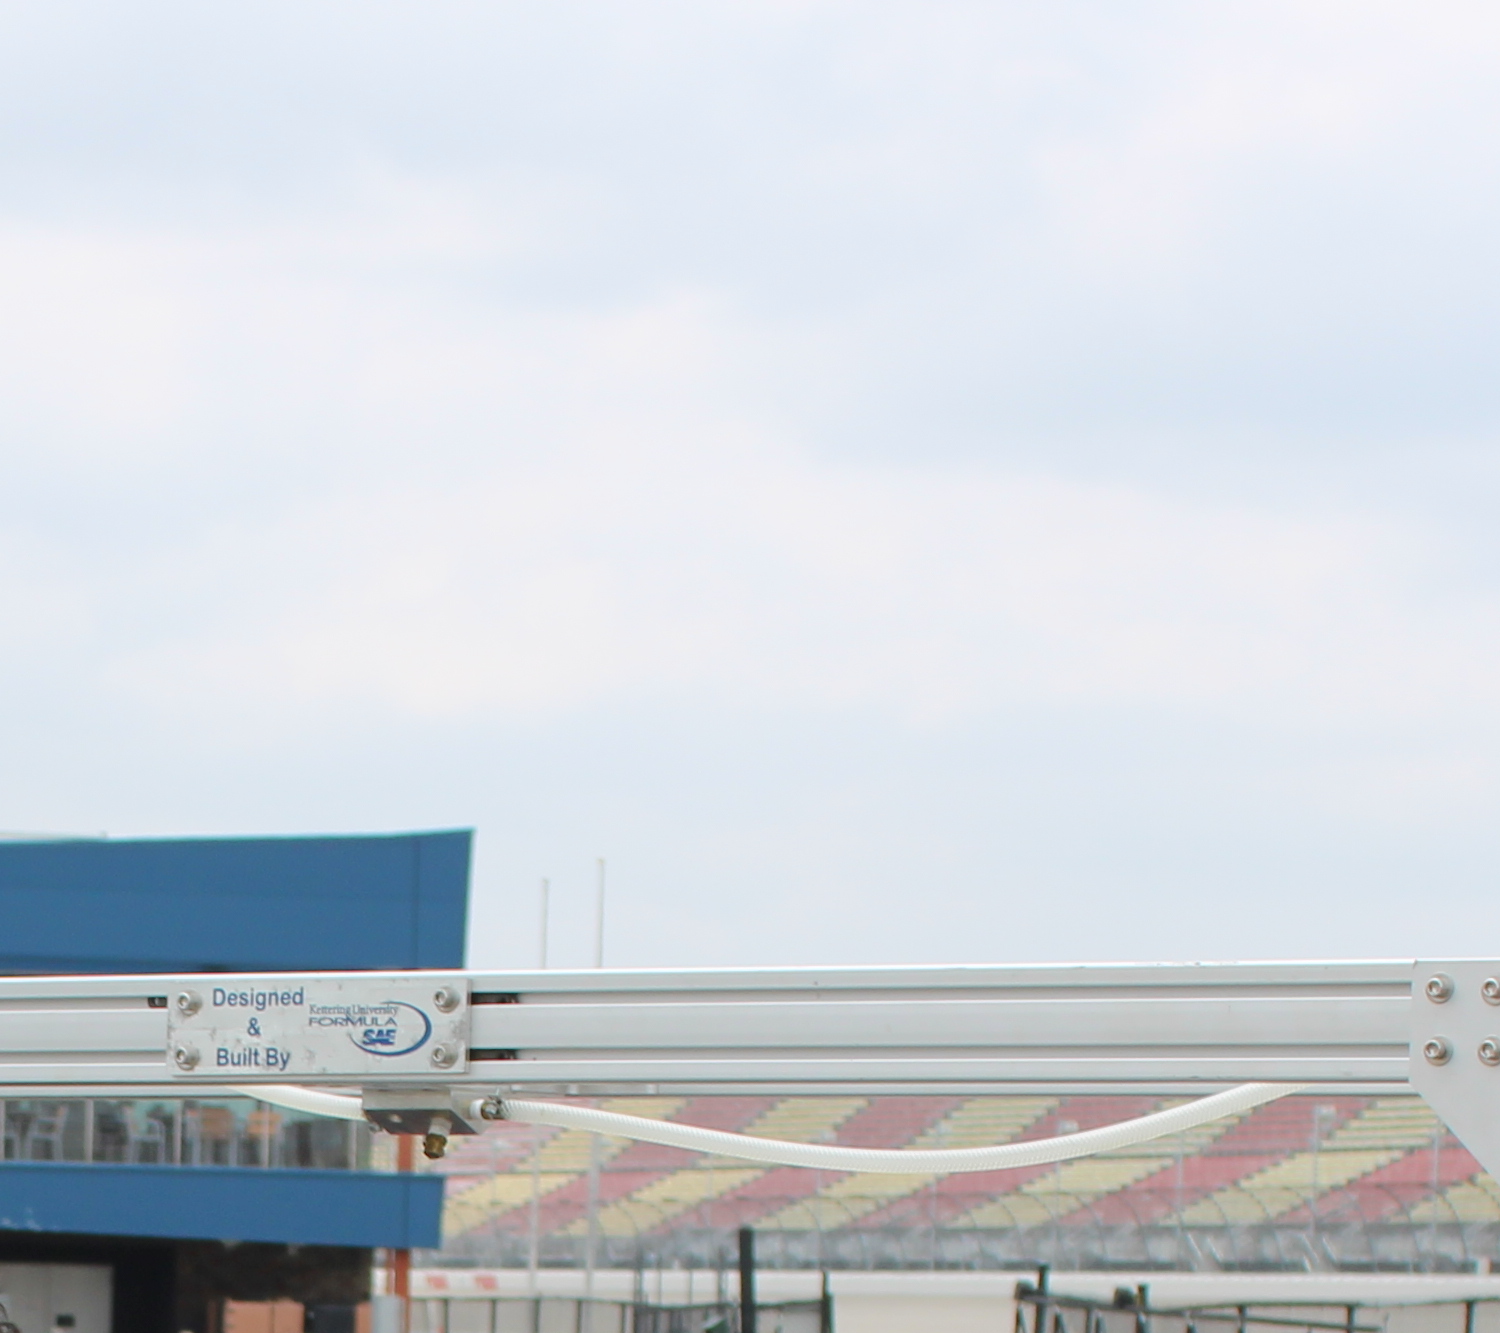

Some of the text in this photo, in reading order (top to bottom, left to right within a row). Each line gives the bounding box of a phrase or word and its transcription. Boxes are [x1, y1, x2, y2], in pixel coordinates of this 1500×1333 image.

[212, 987, 304, 1009] Designed
[309, 1004, 398, 1017] Kettering University
[247, 1017, 261, 1036] &
[309, 1017, 398, 1026] FORMULA
[217, 1048, 290, 1071] Built By
